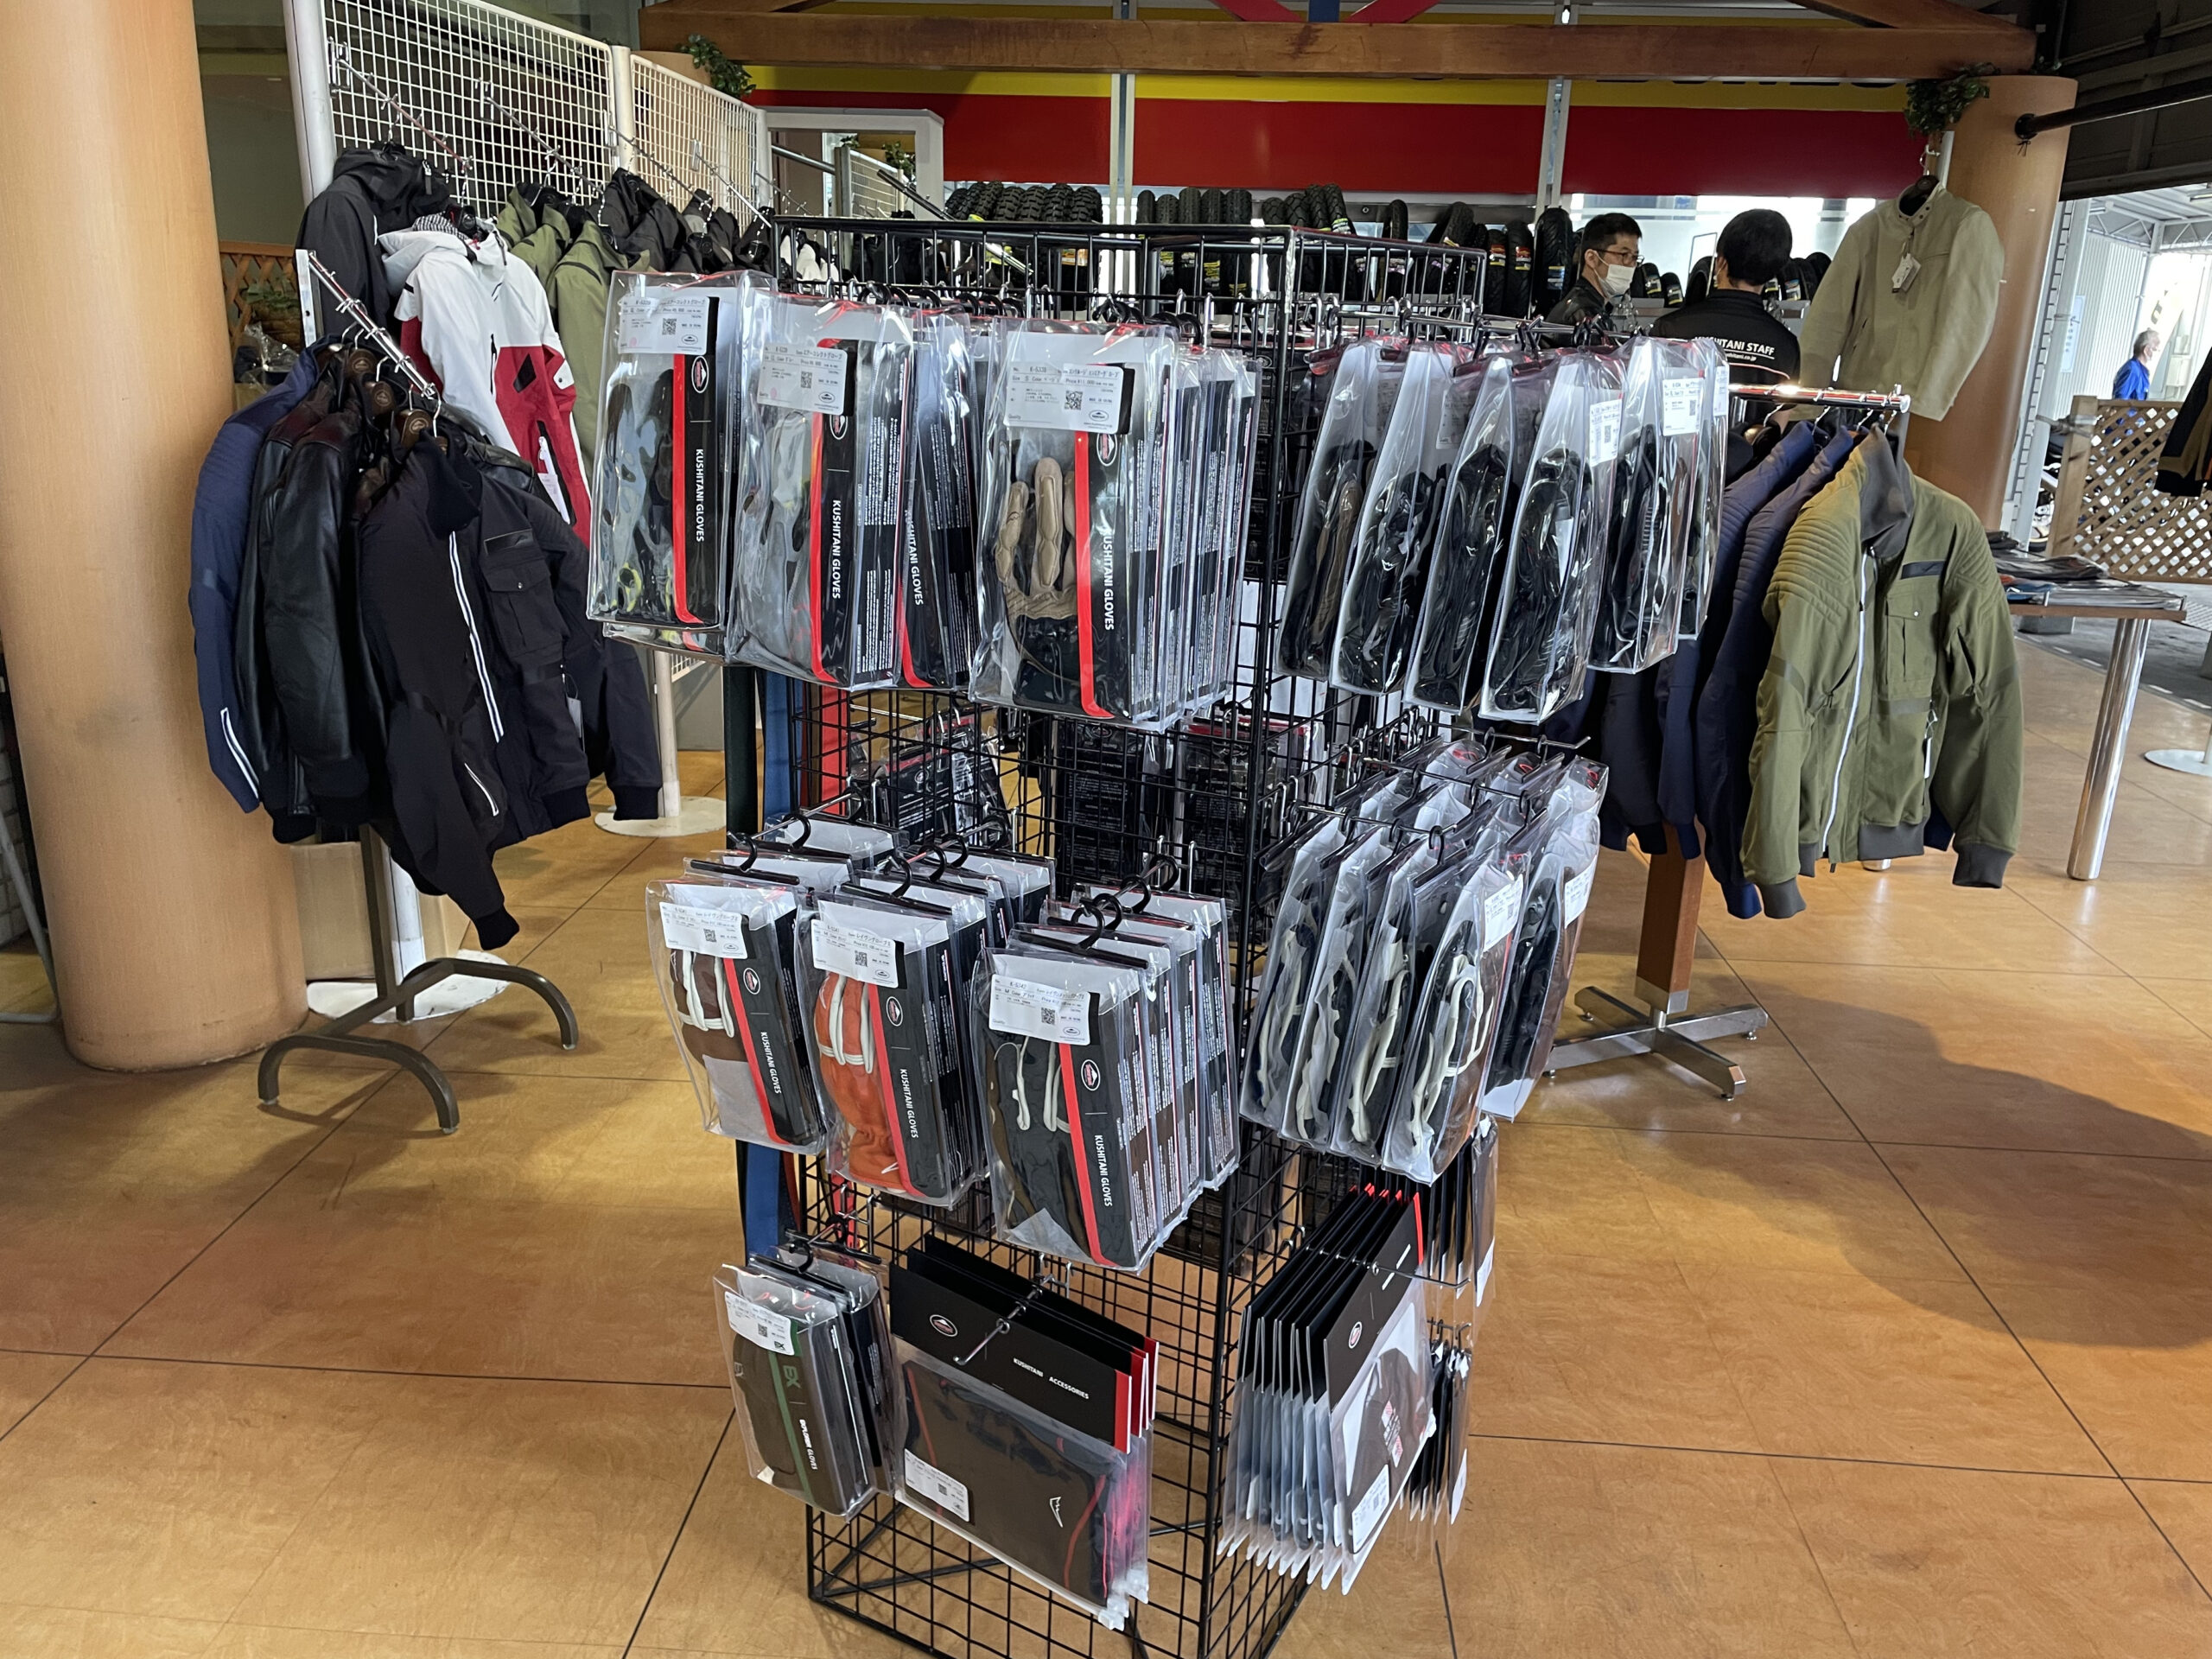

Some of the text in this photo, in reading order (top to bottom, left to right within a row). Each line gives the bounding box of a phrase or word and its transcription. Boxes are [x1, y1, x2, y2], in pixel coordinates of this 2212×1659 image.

[1746, 343, 1775, 355] STAFF
[696, 448, 704, 543] KUSHITANI GLOVES
[832, 499, 842, 600] KUSHITANI GLOVES
[912, 566, 924, 606] GLOVES
[1104, 588, 1115, 631] GLOVES
[760, 1031, 782, 1094] KUSHITANI GLOVES
[899, 1068, 918, 1139] KUSHITANI GLOVES
[1094, 1135, 1113, 1207] KUSHITANI GLOVES
[1048, 1376, 1090, 1400] ACCESSORIES
